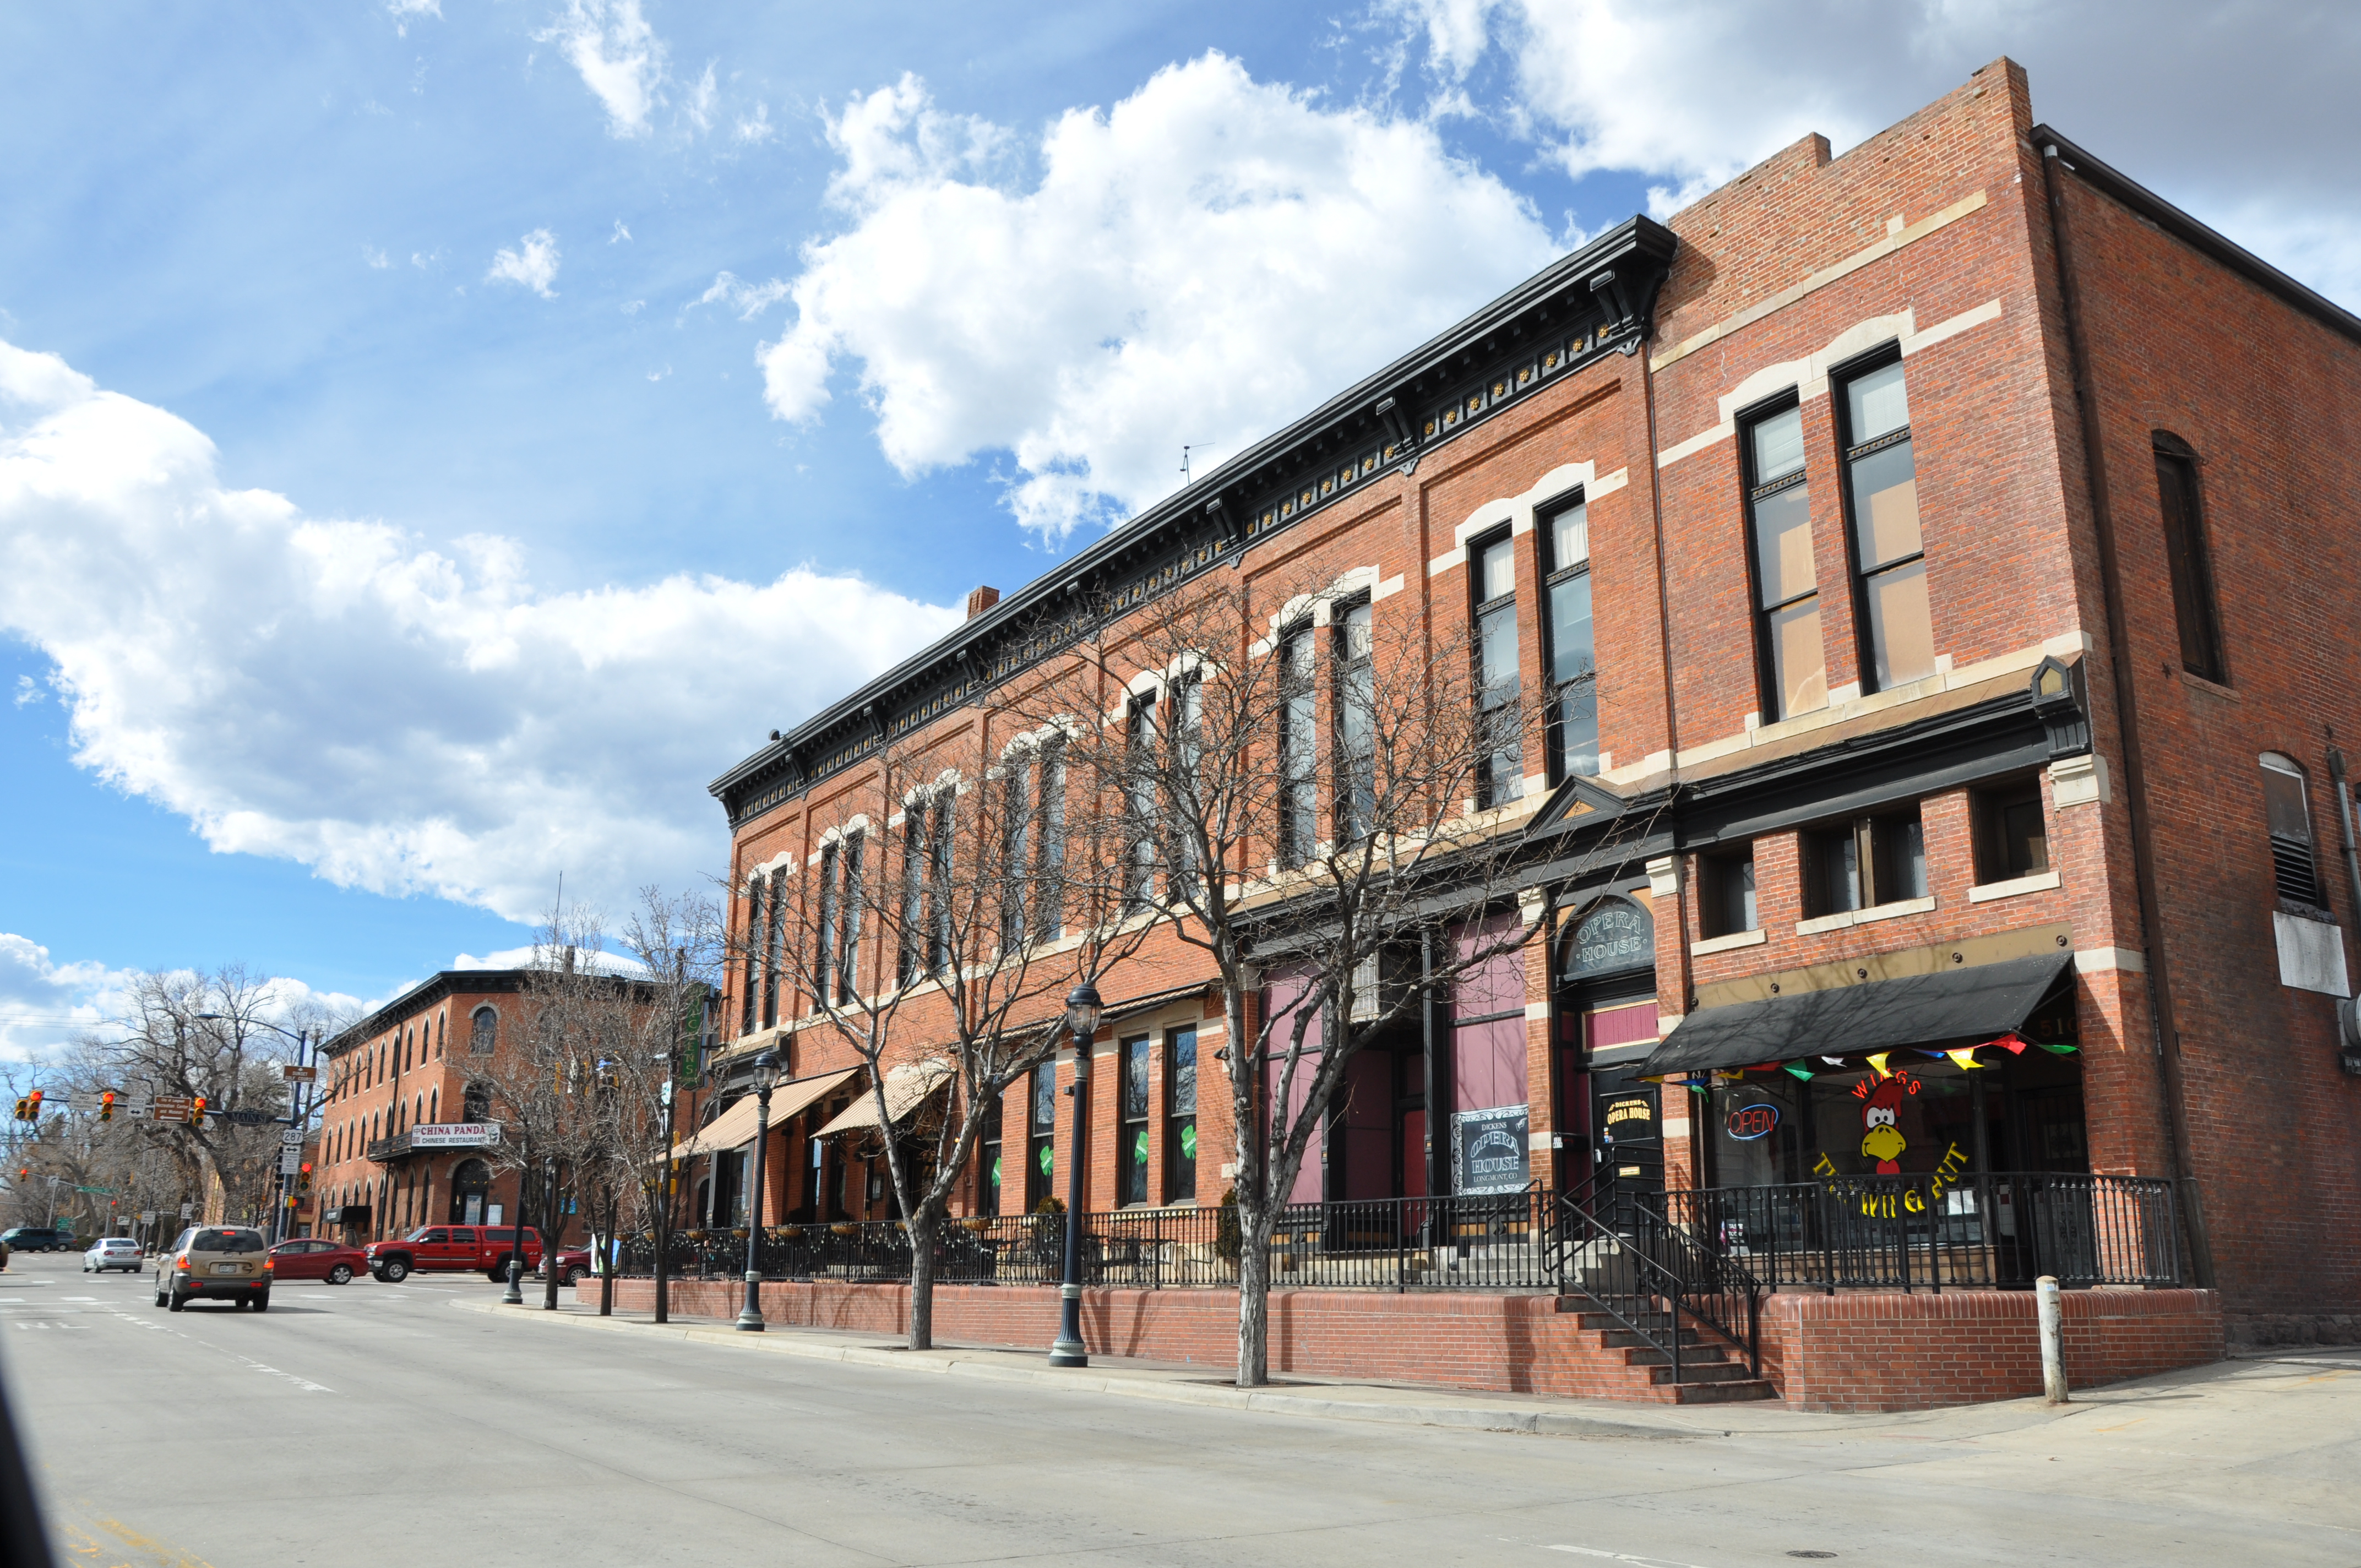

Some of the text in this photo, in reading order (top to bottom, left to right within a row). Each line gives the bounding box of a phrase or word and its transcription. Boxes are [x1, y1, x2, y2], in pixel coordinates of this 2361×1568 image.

[1577, 911, 1641, 944] OPERA
[1582, 936, 1642, 962] HOUSE
[1615, 1099, 1641, 1108] DICKENS
[231, 1113, 256, 1122] MAIN
[1607, 1107, 1650, 1125] OPERA HOUSE
[1728, 1111, 1775, 1133] OPEN
[421, 1125, 486, 1135] CHINA PANDA
[1481, 1121, 1507, 1131] DICKENS
[284, 1133, 302, 1141] 287
[1471, 1131, 1520, 1158] OPERA
[1472, 1156, 1519, 1173] HOUSE
[1932, 1141, 1968, 1200] HUT
[1473, 1173, 1508, 1183] LONGMONT,
